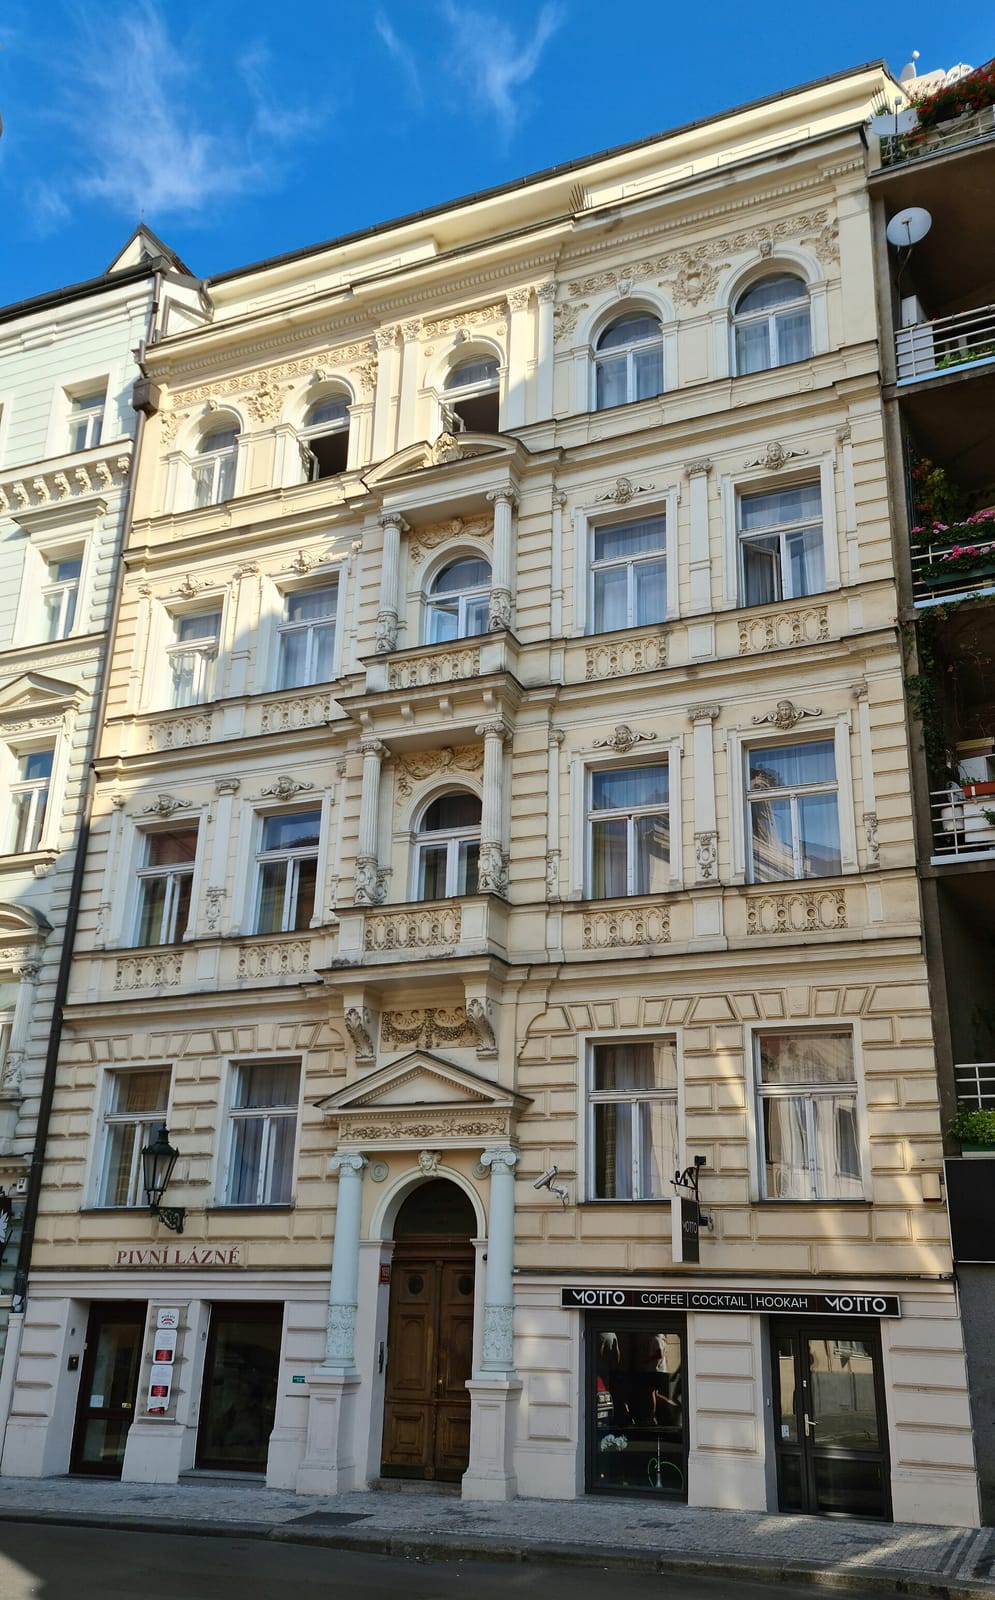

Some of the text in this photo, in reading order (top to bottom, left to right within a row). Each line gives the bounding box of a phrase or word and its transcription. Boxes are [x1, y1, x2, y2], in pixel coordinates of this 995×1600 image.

[117, 1246, 169, 1264] PIVNÍ
[572, 1290, 887, 1312] MOTTO COFFEE COCKTAIL HOOKAH MOTTO
